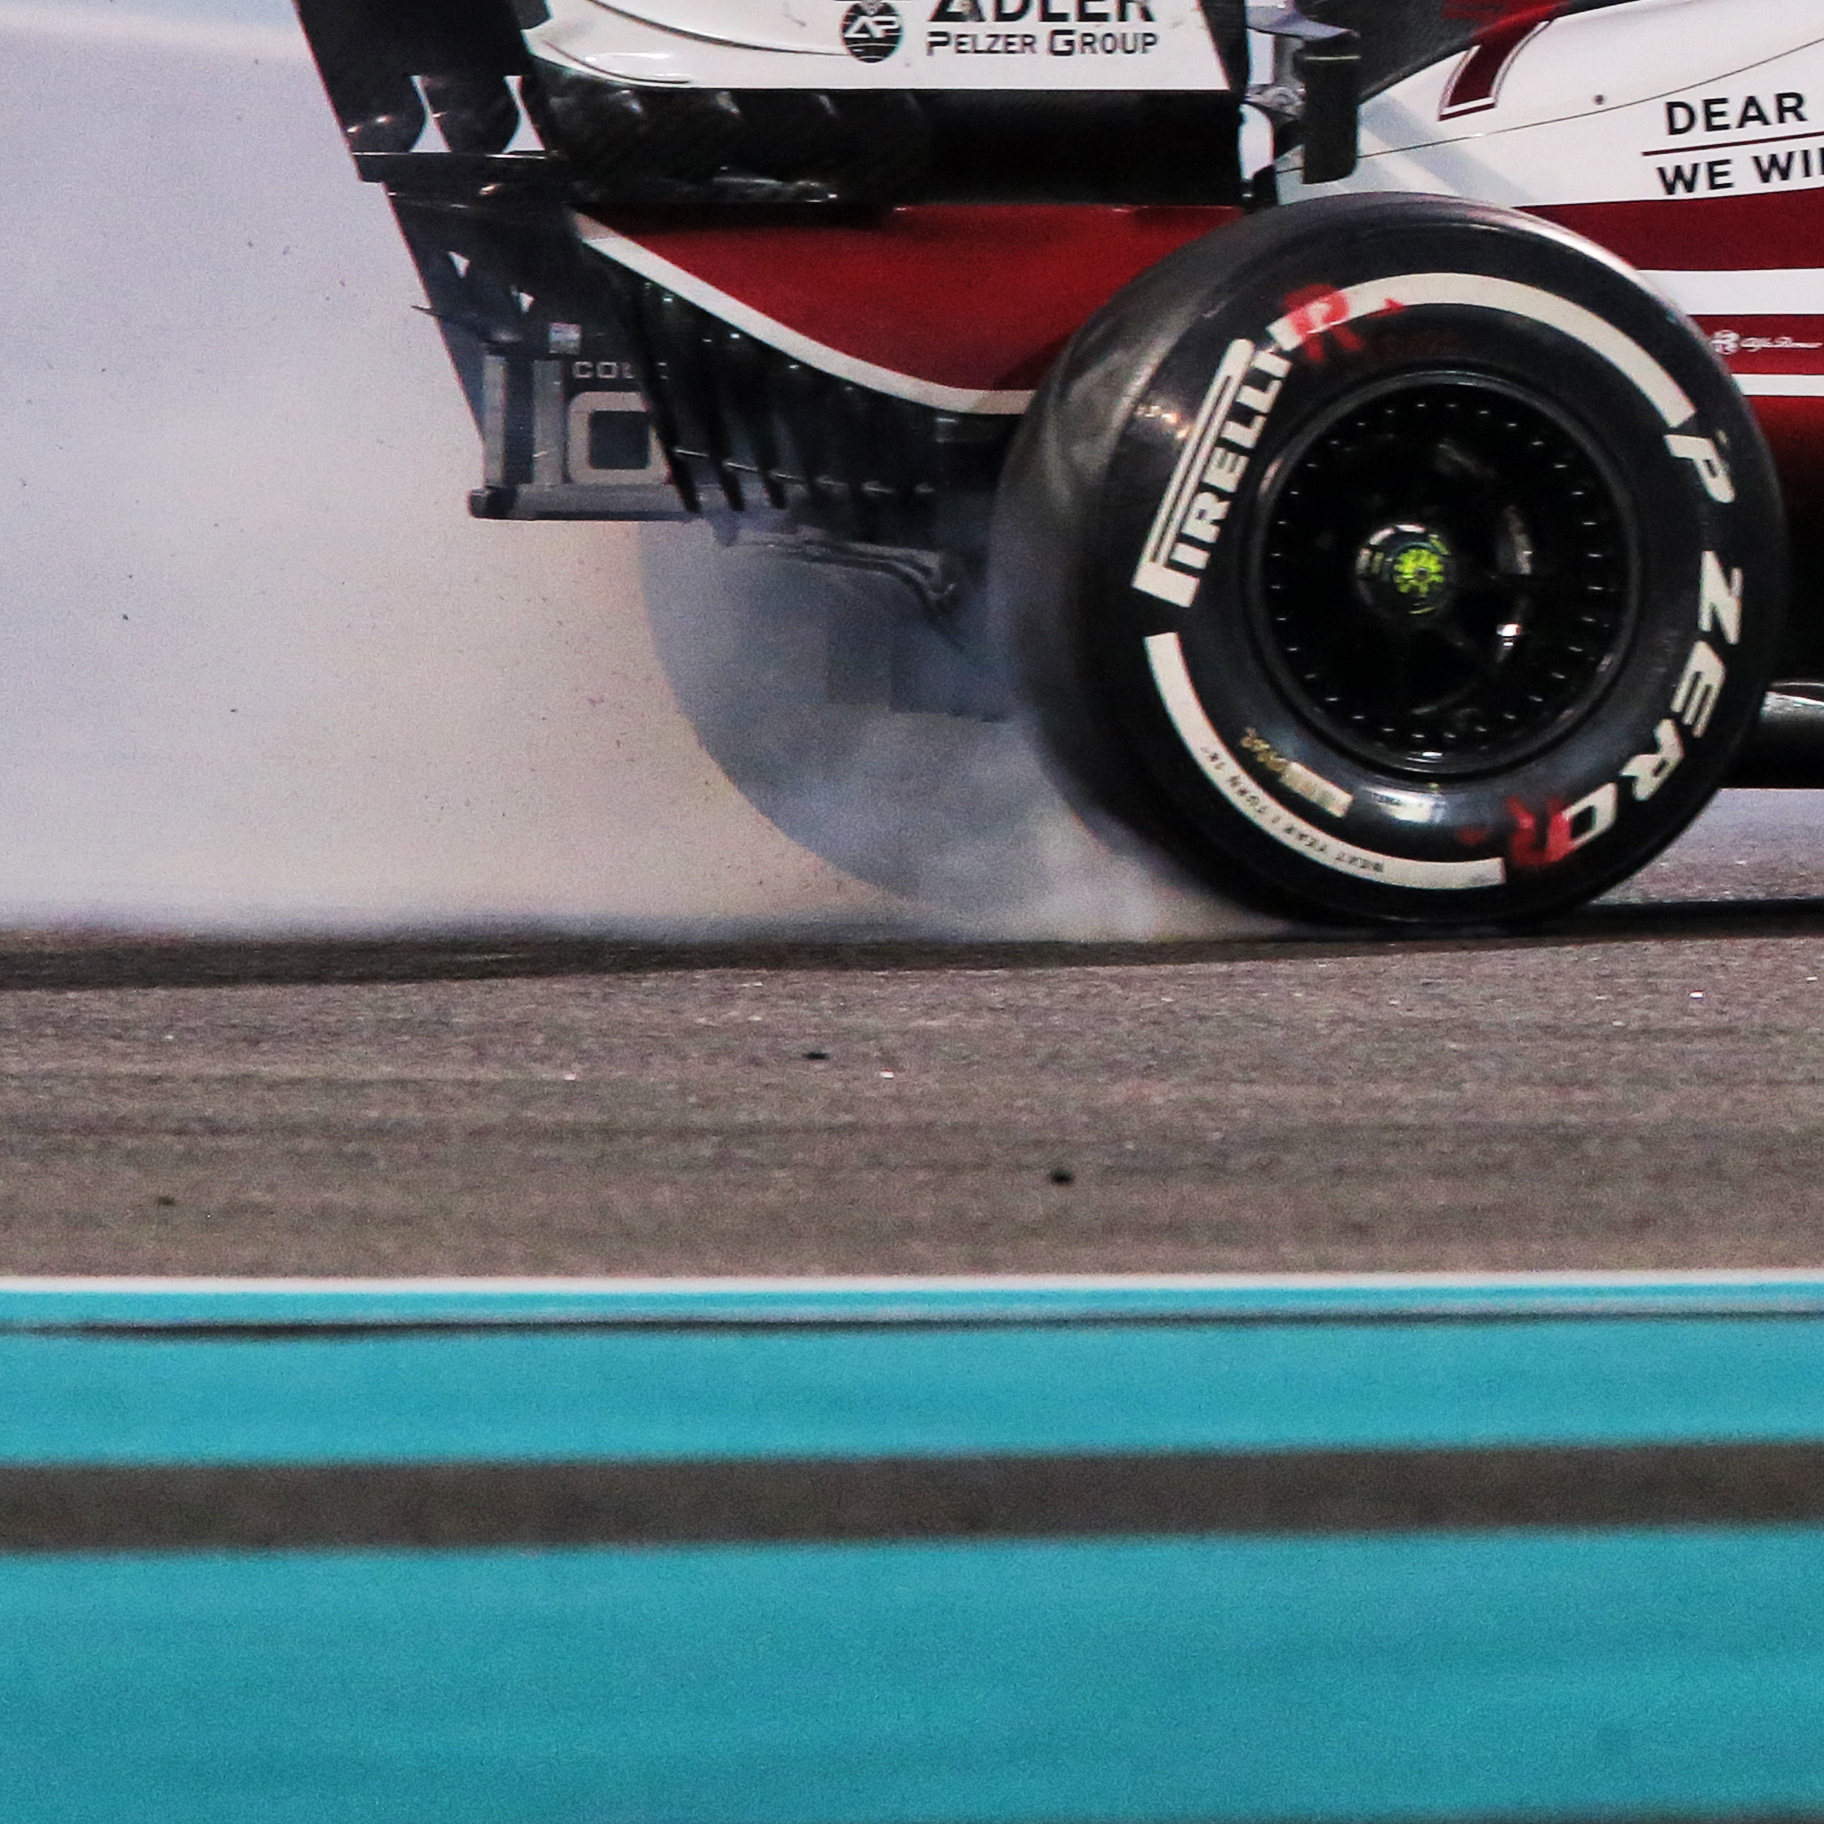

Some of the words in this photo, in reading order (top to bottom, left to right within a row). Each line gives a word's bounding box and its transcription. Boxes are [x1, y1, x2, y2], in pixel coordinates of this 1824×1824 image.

[927, 29, 1037, 56] PELZER
[1048, 28, 1160, 56] GROUP
[1666, 91, 1807, 136] DEAR
[1658, 161, 1735, 197] WE
[1131, 338, 1293, 609] PIRELLI
